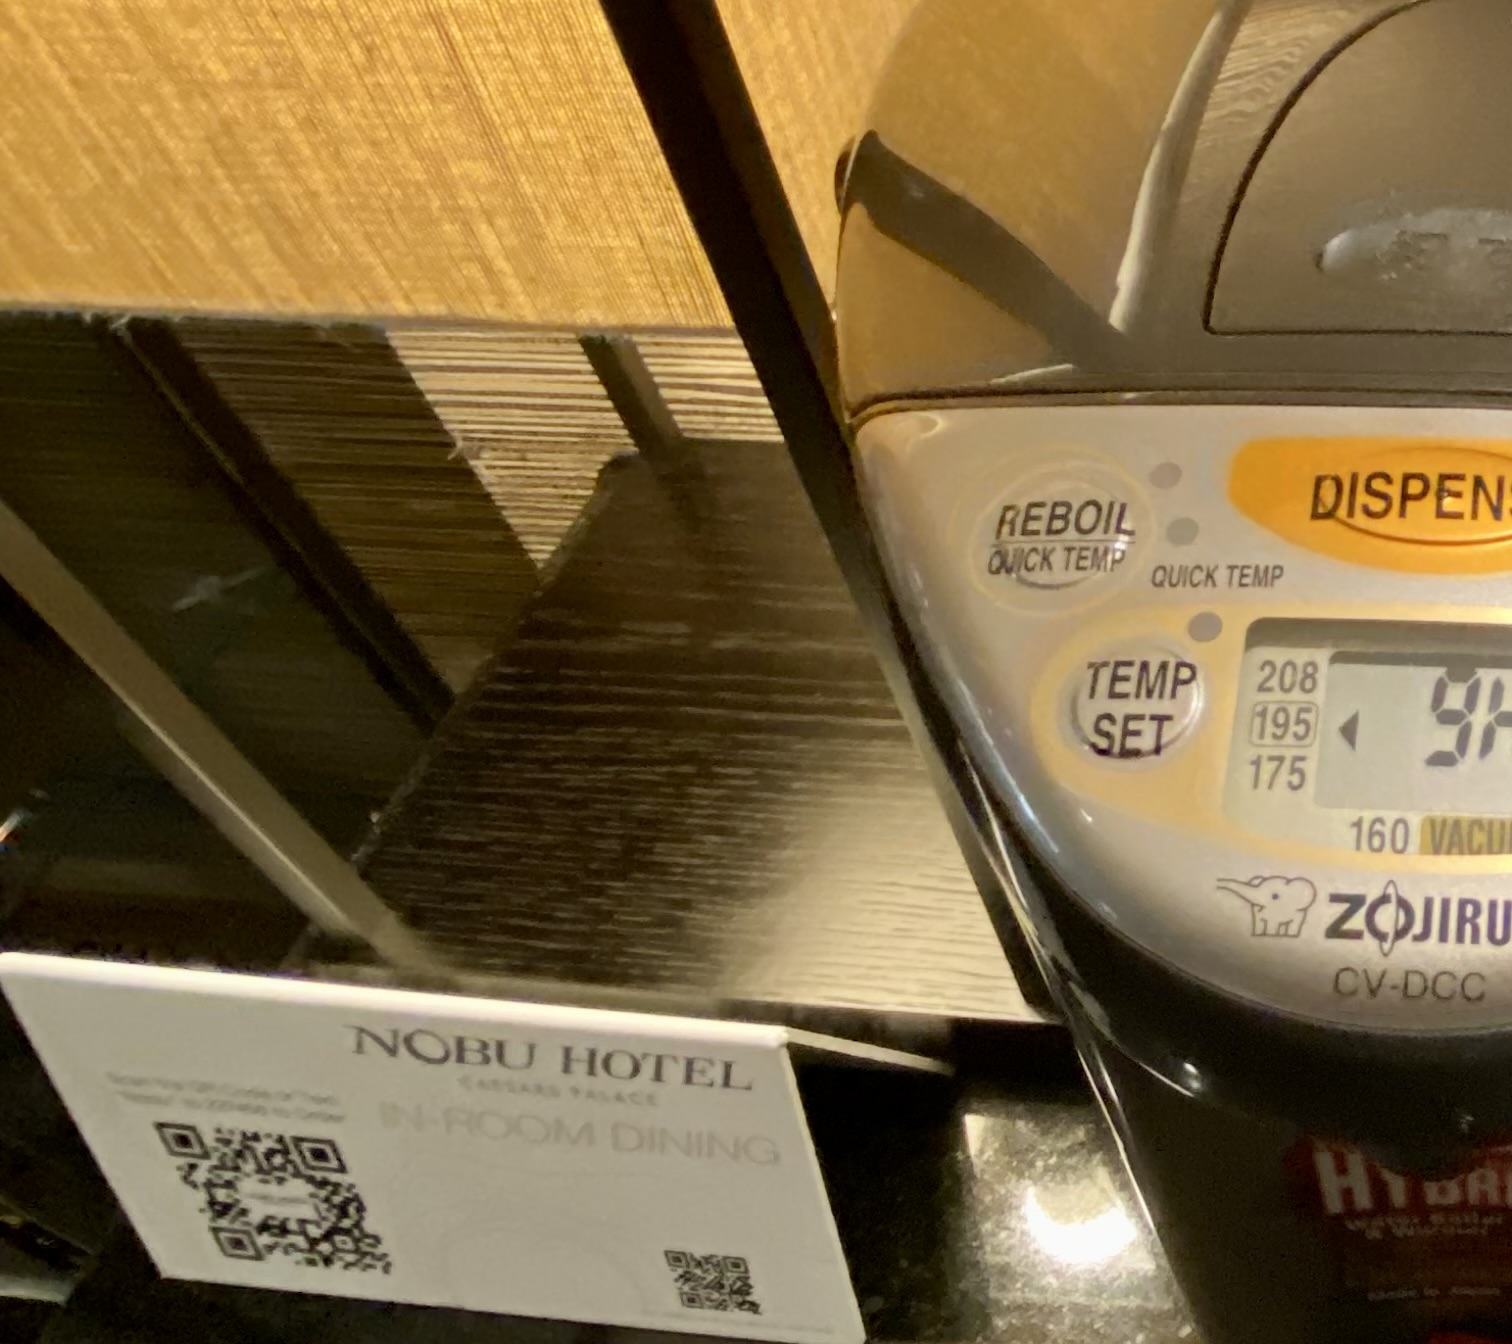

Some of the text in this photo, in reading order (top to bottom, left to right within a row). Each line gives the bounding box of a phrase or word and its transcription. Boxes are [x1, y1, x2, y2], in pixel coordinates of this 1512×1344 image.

[995, 498, 1136, 540] REBOIL
[988, 543, 1127, 576] QUICK TEMP
[1151, 564, 1285, 590] QUICK TEMP
[1086, 659, 1198, 702] TEMP
[1256, 659, 1319, 694] 208
[1091, 712, 1174, 758] SET
[1253, 706, 1313, 742] 195
[1249, 754, 1308, 792] 175
[1350, 816, 1411, 856] 160
[1333, 966, 1487, 1003] CV-DCC
[343, 1025, 753, 1091] NOBU HOTEL
[379, 1101, 596, 1148] IN-ROOM
[610, 1121, 782, 1165] DINING
